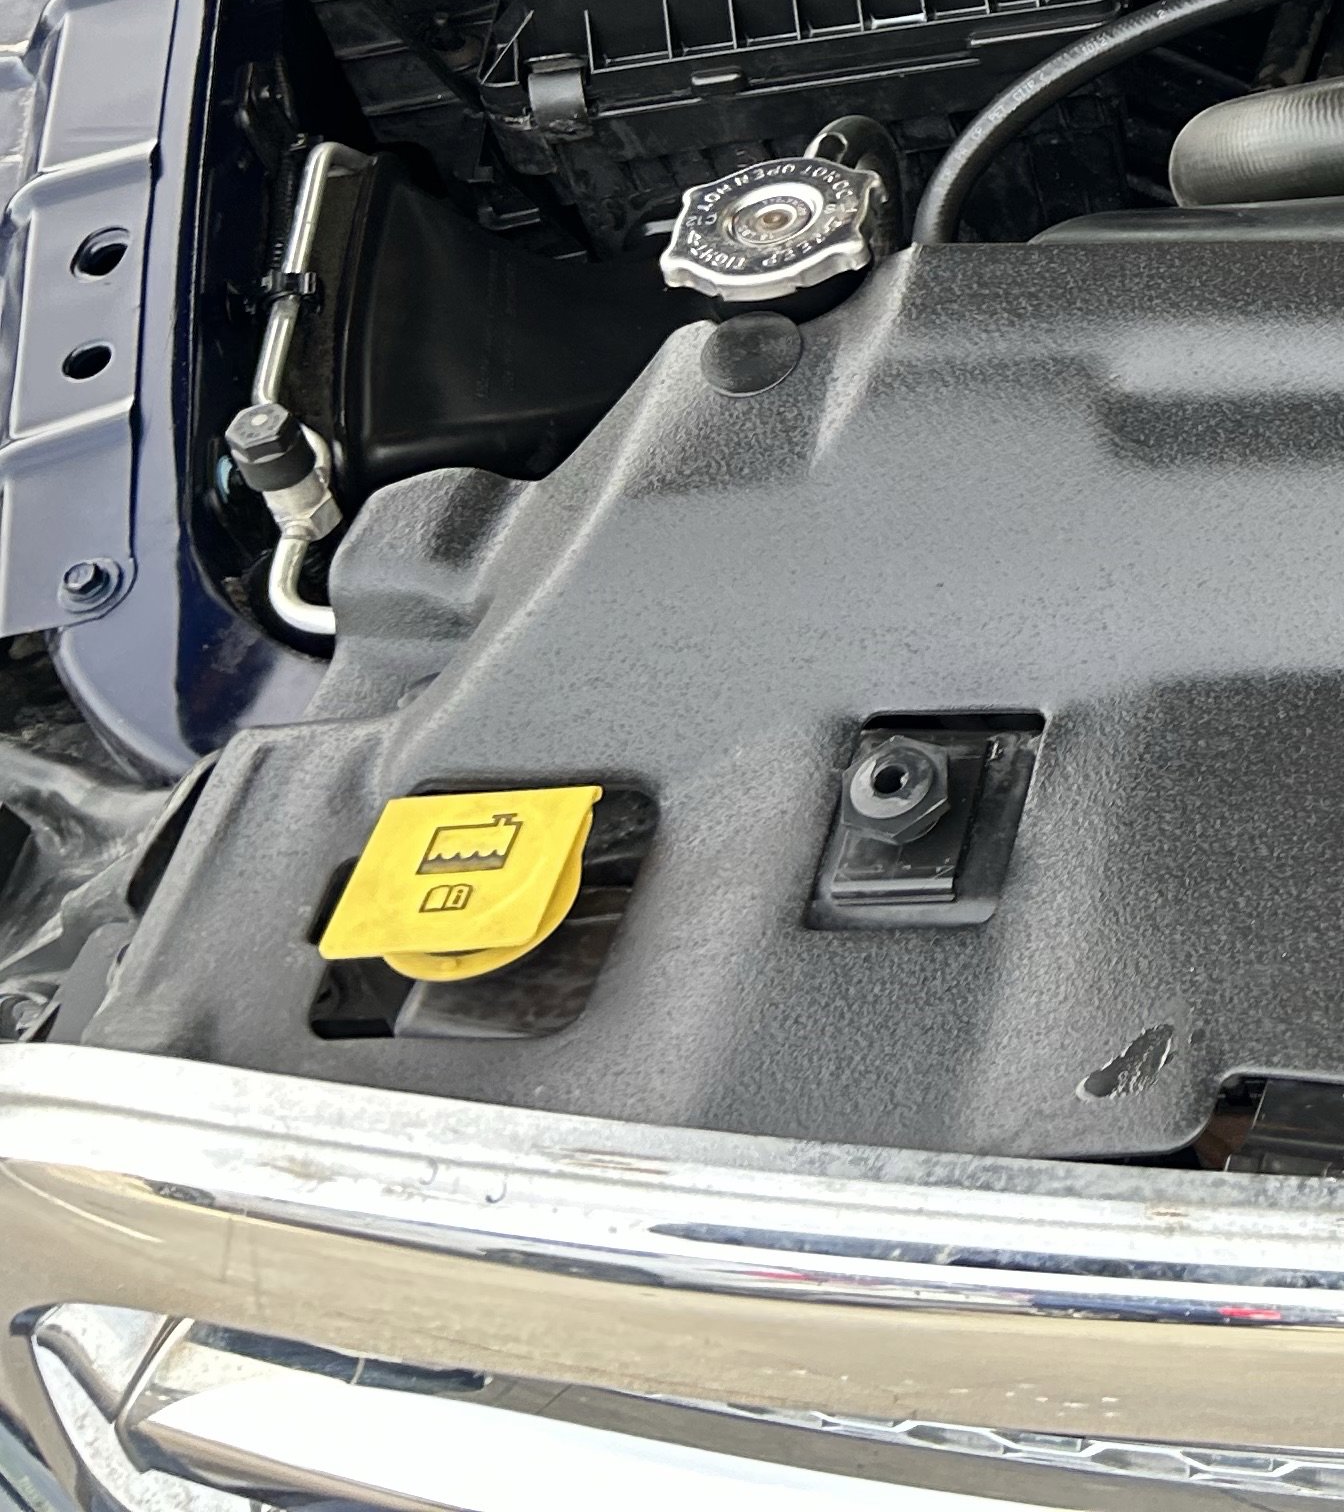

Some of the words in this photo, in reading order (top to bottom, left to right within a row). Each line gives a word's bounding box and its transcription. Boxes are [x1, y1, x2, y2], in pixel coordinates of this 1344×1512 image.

[734, 163, 796, 187] OPEN
[801, 165, 840, 183] NOT
[697, 184, 732, 212] HOT
